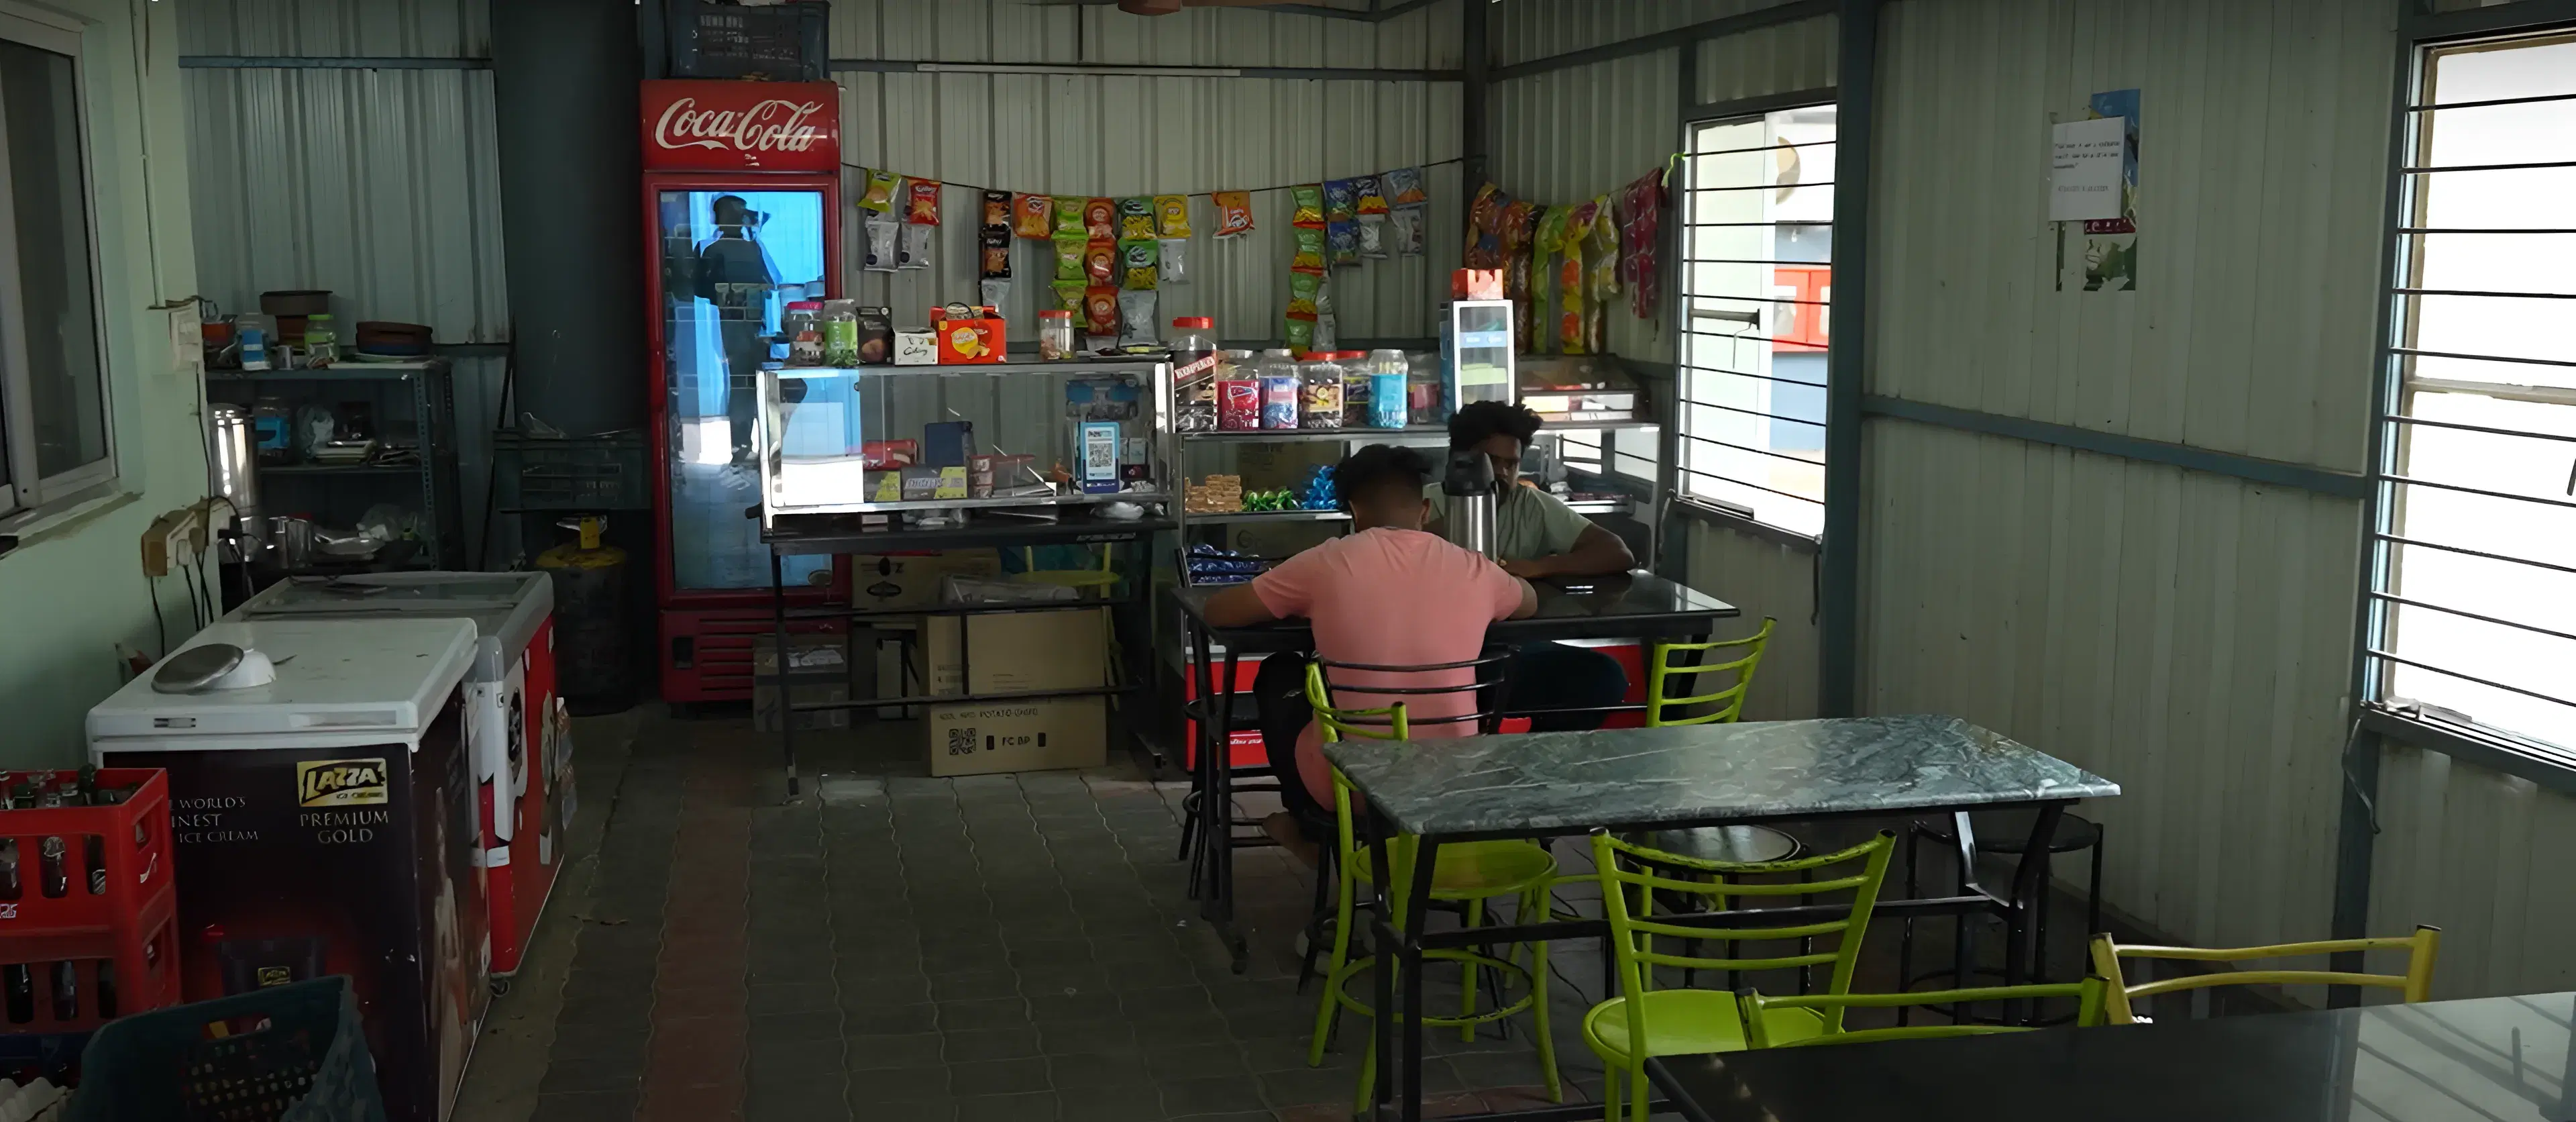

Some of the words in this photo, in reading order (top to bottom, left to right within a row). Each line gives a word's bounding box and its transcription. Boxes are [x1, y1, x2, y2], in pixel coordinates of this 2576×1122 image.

[305, 767, 378, 801] LAZZA
[179, 795, 246, 809] WORLD'S
[171, 813, 222, 828] INEST
[300, 810, 389, 827] PREMIUM
[207, 830, 259, 843] CREAM
[317, 828, 374, 844] GOLD
